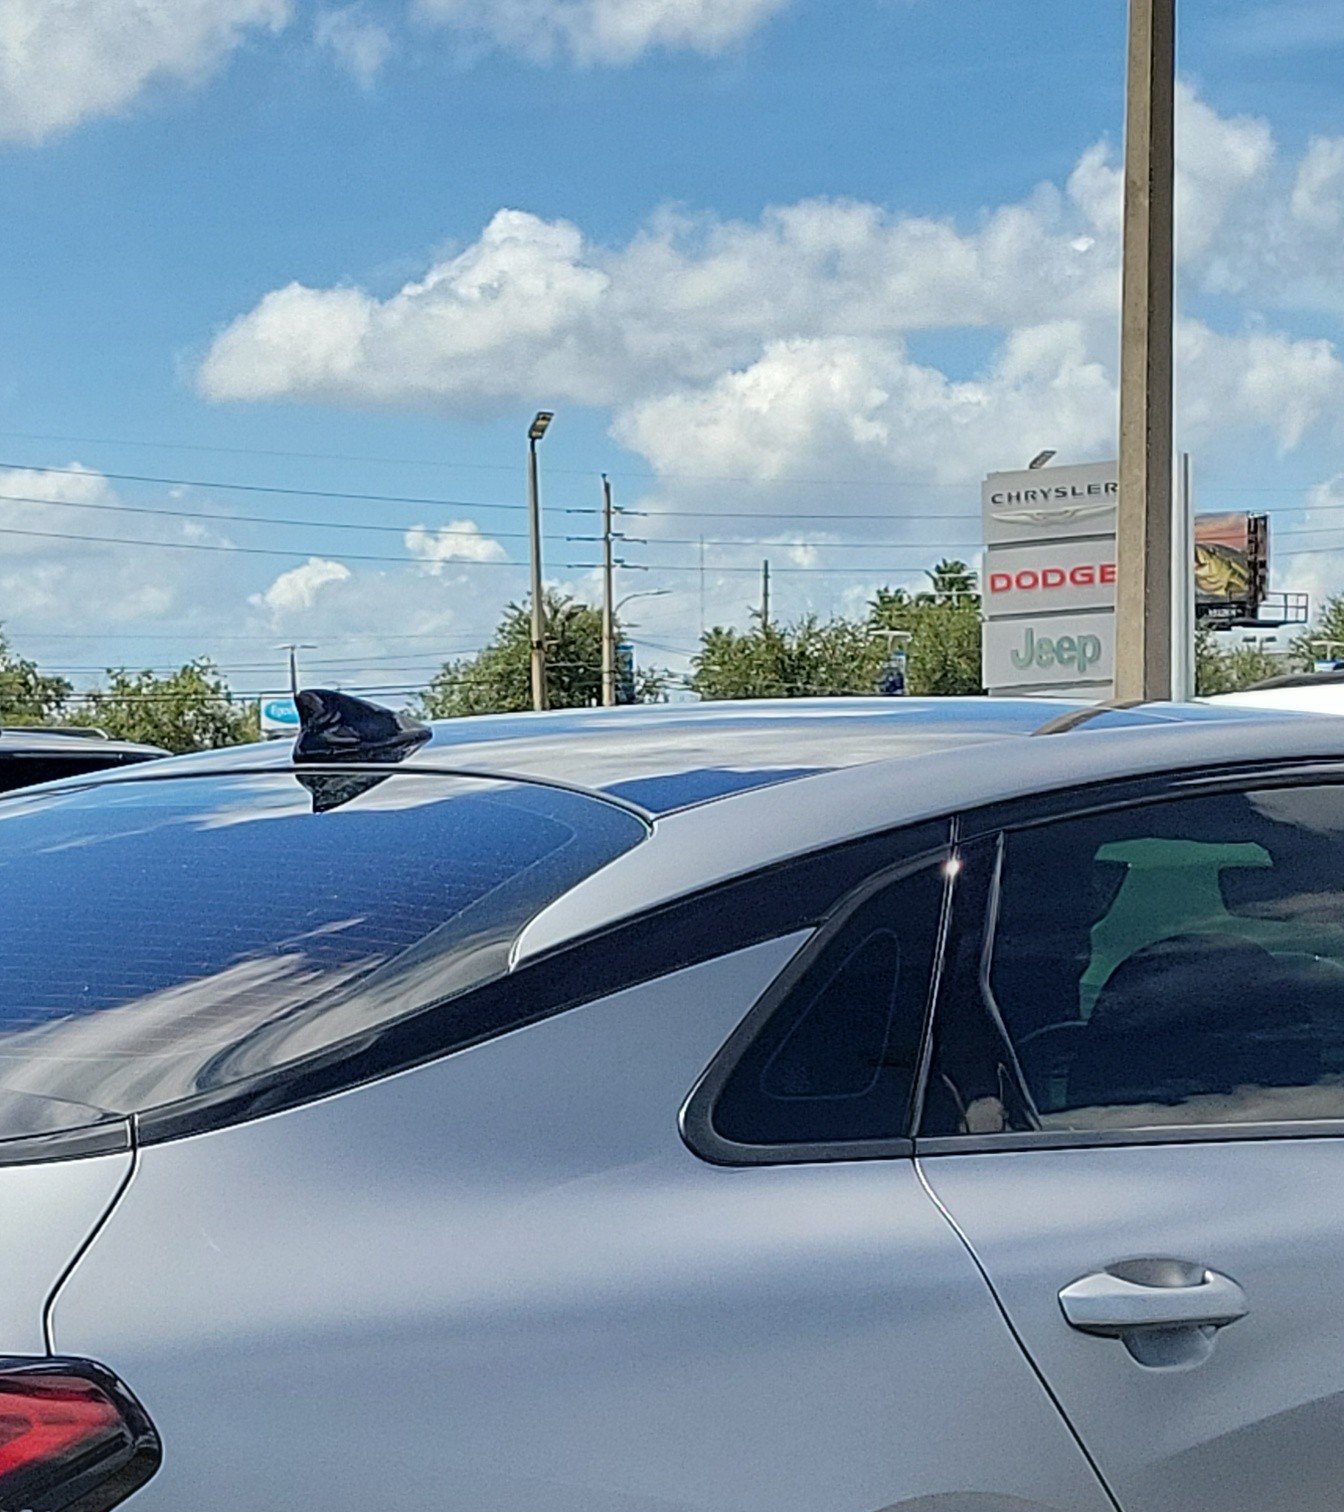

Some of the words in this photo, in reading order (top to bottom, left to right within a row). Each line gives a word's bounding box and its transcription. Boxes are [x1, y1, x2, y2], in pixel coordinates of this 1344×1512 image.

[991, 482, 1118, 504] CHRYSLER
[990, 564, 1116, 593] DODGE
[1011, 627, 1101, 673] Jeep
